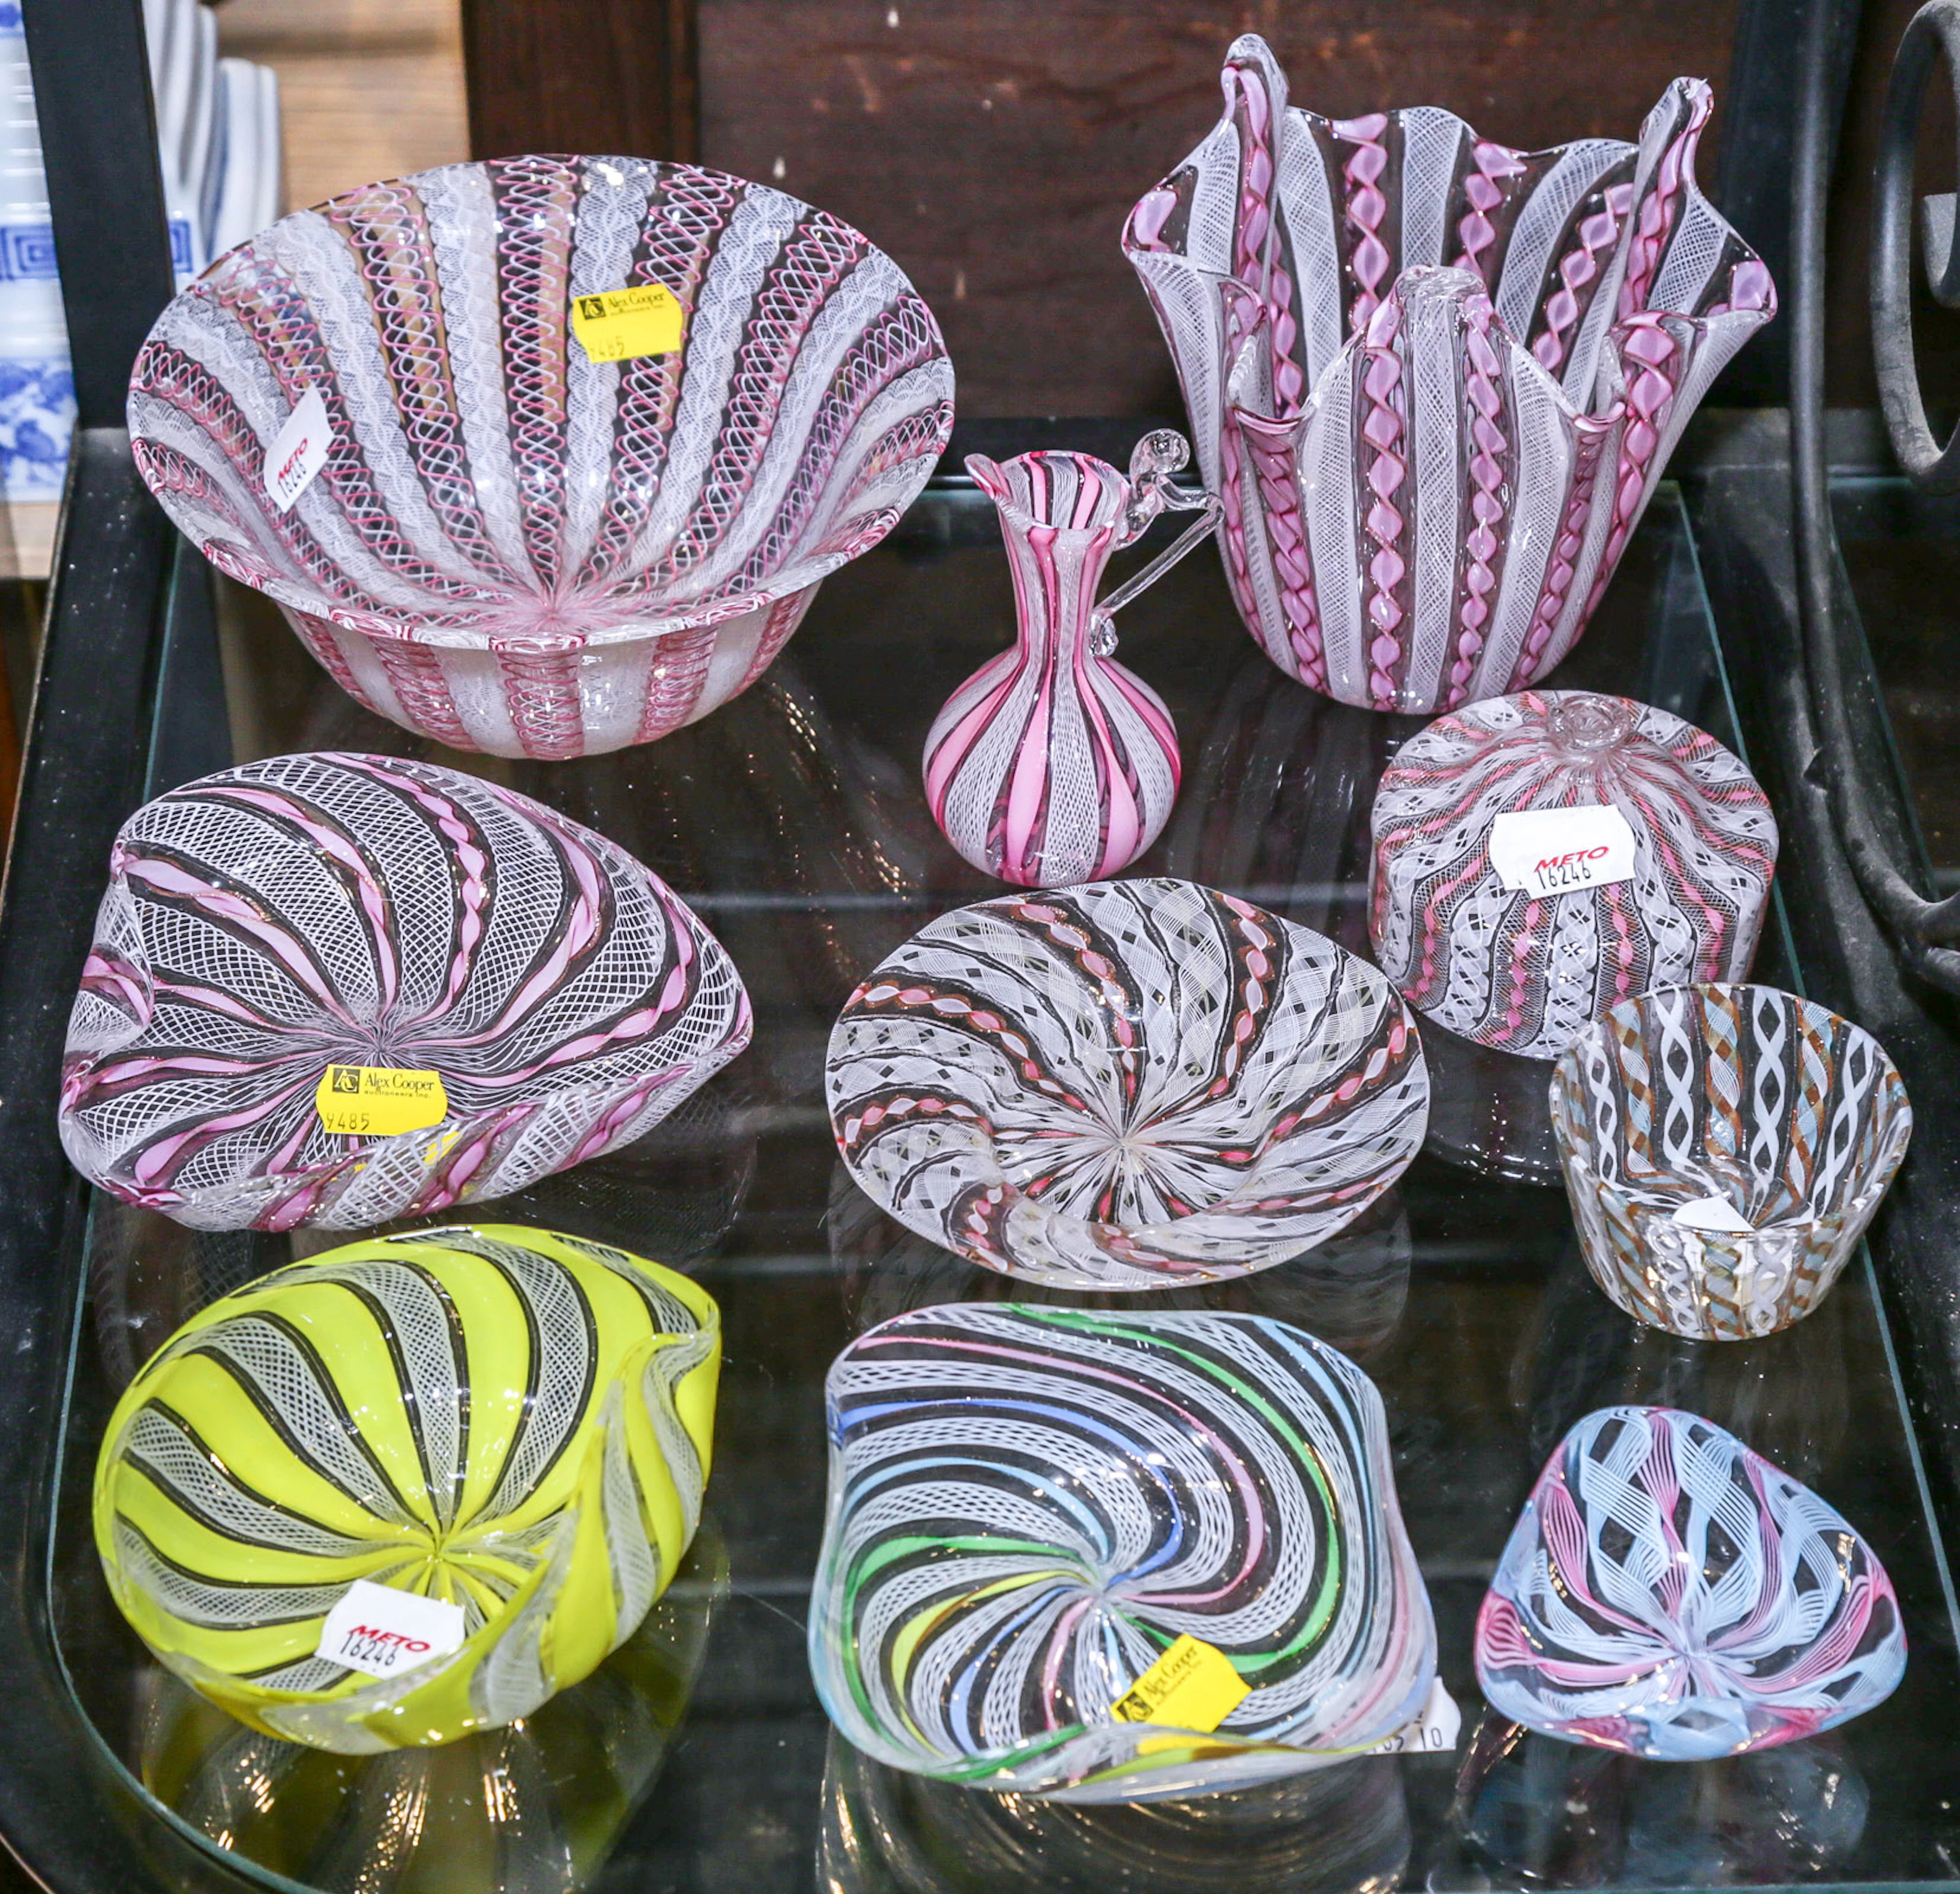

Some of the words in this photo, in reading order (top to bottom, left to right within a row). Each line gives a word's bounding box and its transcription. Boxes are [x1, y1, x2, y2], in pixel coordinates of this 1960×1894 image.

[1534, 846, 1609, 873] METO
[1537, 860, 1591, 890] 16246
[364, 1073, 390, 1087] Alex
[393, 1074, 434, 1093] Cooper
[326, 1112, 370, 1131] 9485
[340, 1632, 400, 1666] 16246
[348, 1625, 431, 1652] METO
